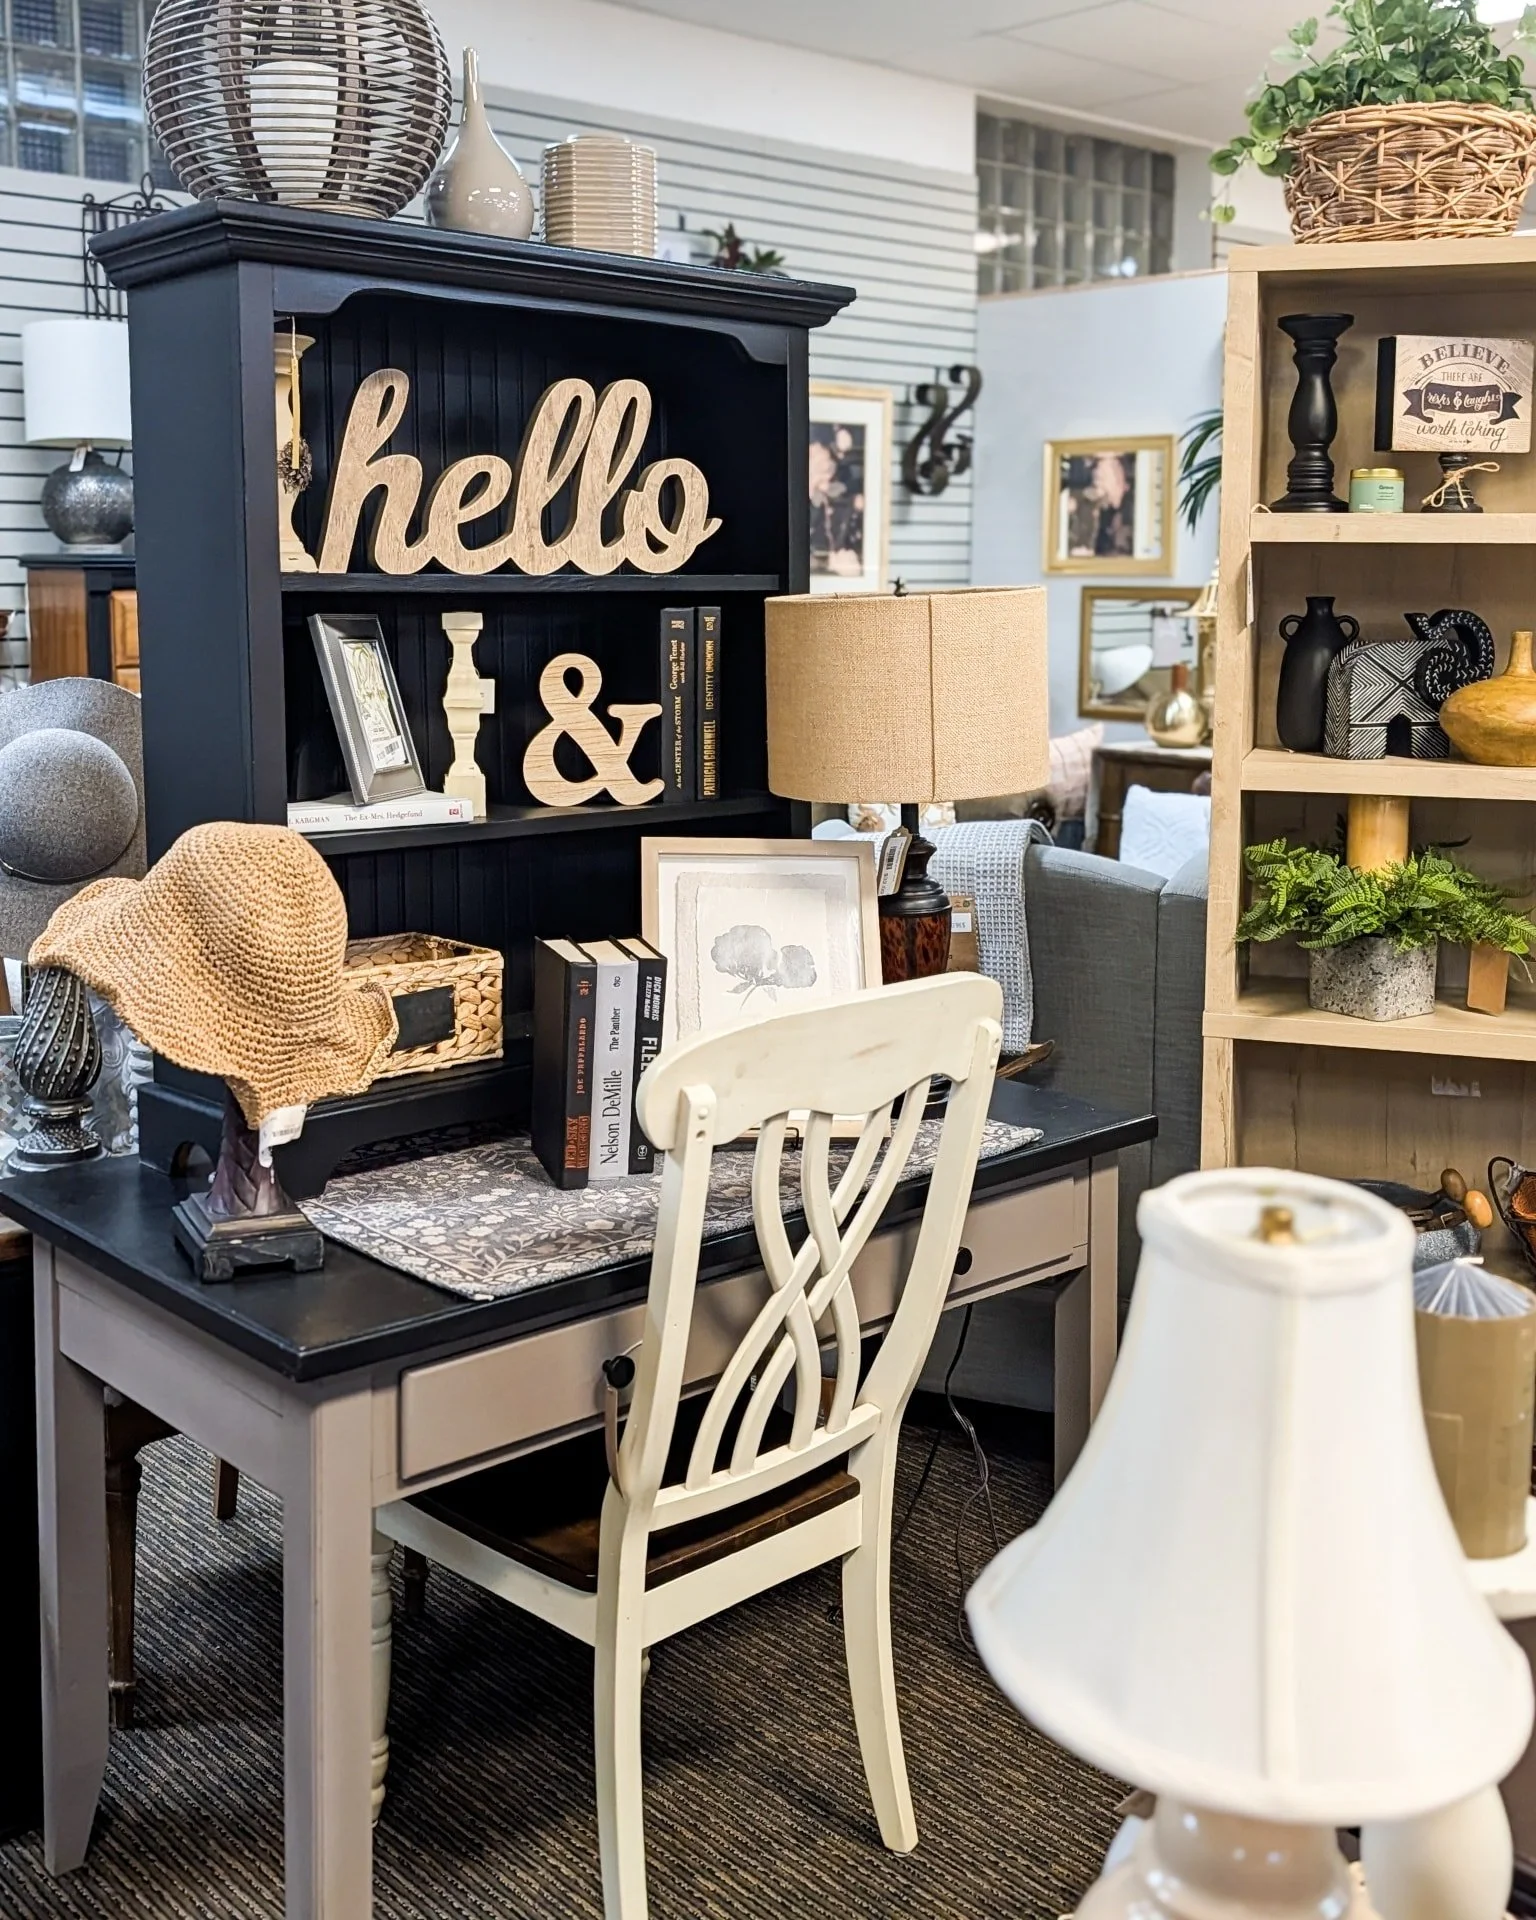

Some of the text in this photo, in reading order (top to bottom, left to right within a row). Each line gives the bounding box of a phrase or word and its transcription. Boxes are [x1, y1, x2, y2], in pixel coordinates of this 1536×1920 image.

[1418, 343, 1510, 375] BELIEVE
[1441, 371, 1482, 383] THERE ARE
[1427, 391, 1450, 409] risks
[1453, 390, 1463, 410] &
[1416, 418, 1508, 451] worth taking
[316, 367, 723, 576] hello
[669, 640, 680, 690] George Tenet
[705, 674, 714, 710] IDENTITY
[674, 695, 682, 725] STORM
[523, 652, 665, 807] &
[674, 740, 682, 775] CENTER
[703, 720, 716, 796] PATRICIA CORNWELL
[295, 815, 330, 825] KARGMAN
[344, 813, 358, 821] The
[386, 810, 423, 820] Hedgefund
[651, 976, 662, 1021] DICK MORRIS
[609, 1007, 621, 1051] The Panther
[640, 1037, 659, 1075] FLEE
[576, 1079, 585, 1094] JOE
[600, 1070, 622, 1165] Nelson DeMille
